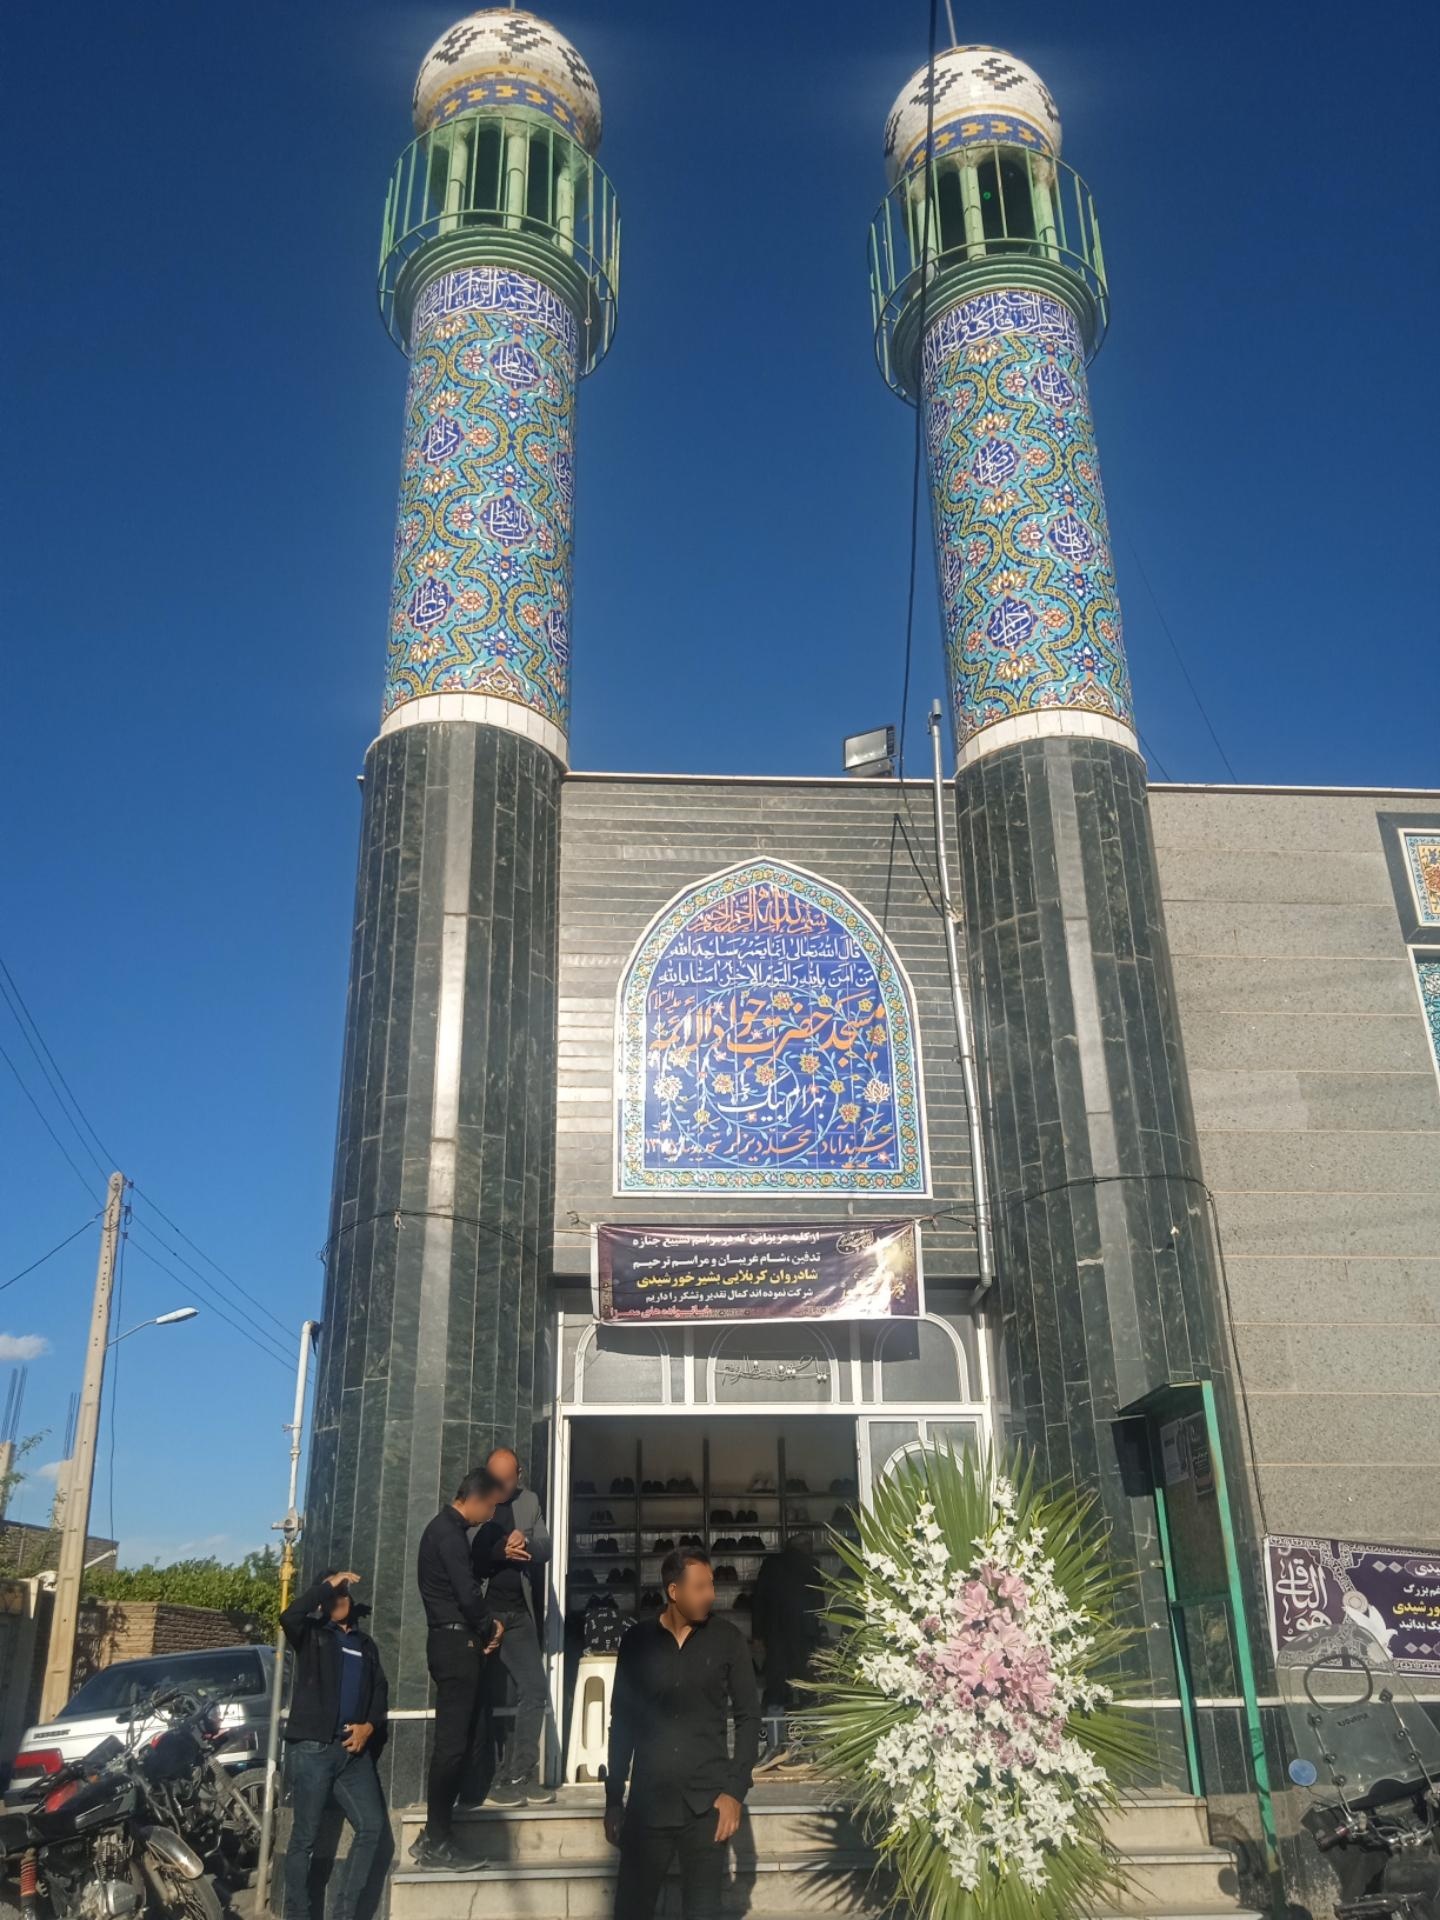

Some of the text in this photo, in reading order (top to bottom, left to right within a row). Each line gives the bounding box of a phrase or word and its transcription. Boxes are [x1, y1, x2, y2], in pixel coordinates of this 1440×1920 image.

[727, 1002, 833, 1066] حضرت
[818, 990, 885, 1066] مسجد
[632, 1234, 661, 1248] جنازه
[632, 1256, 671, 1269] ترحیم
[671, 1255, 709, 1268] مراسم
[718, 1253, 759, 1266] غریبان
[637, 1268, 818, 1288] شادروان کربلایی بشیر خورشیدی
[645, 1292, 668, 1303] داریم
[706, 1289, 727, 1301] تقدیر
[727, 1289, 749, 1300] کمال
[787, 1288, 814, 1300] شرکت
